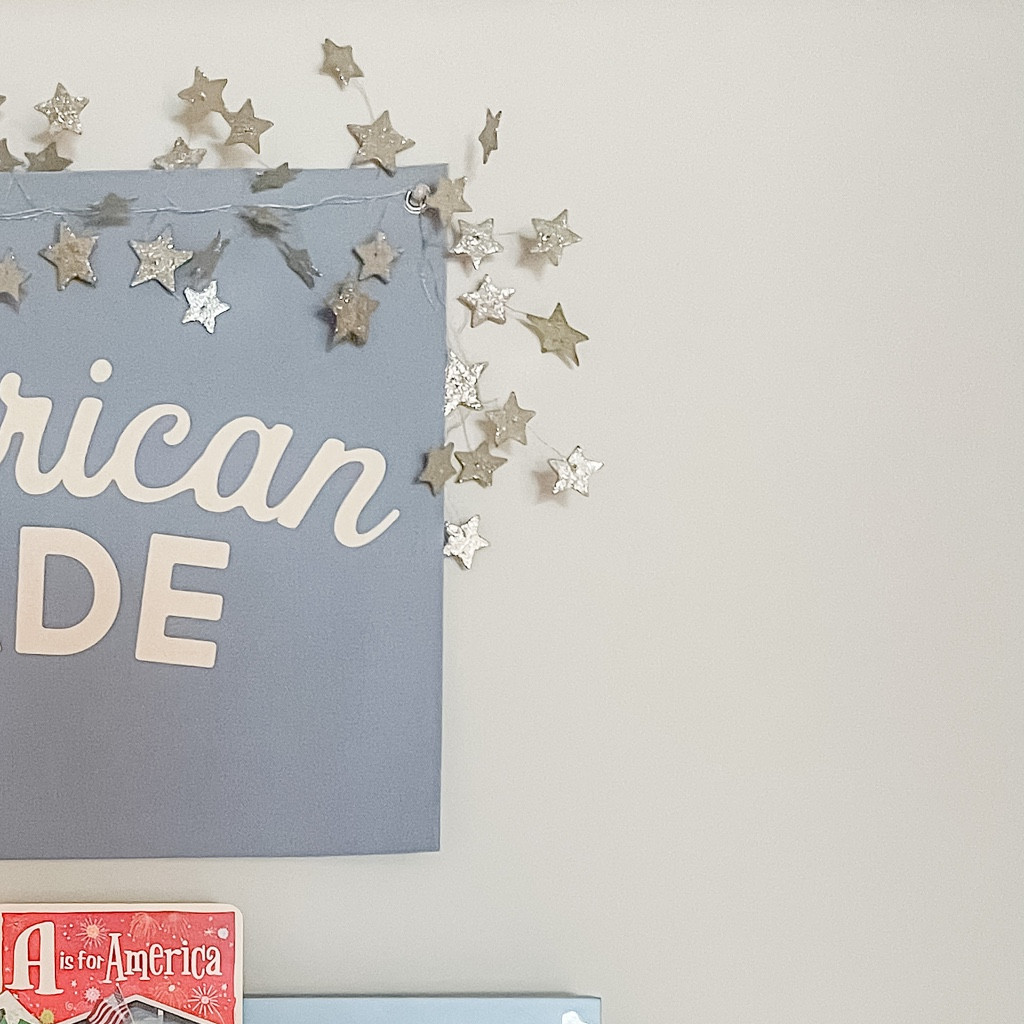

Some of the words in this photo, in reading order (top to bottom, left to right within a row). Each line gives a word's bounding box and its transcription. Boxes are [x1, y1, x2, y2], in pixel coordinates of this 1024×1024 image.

[5, 921, 64, 995] A
[60, 951, 74, 970] is
[77, 949, 105, 970] for
[105, 932, 223, 984] America
